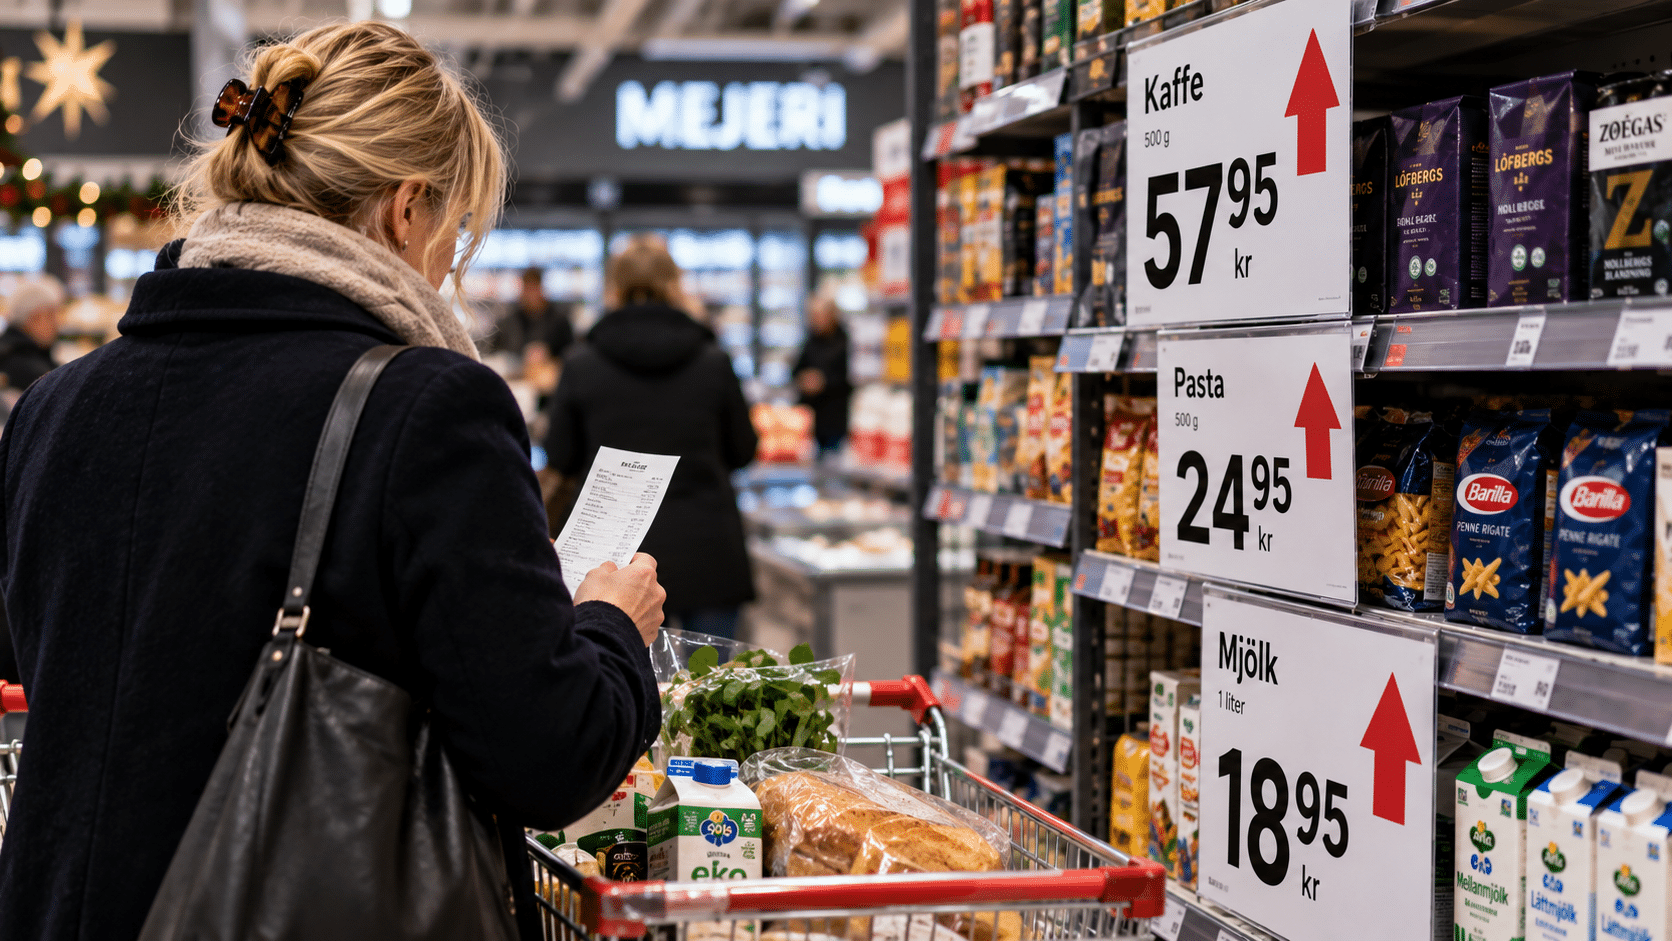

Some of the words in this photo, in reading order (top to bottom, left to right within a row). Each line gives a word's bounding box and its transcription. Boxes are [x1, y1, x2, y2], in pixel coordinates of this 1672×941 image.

[1144, 63, 1204, 115] Kaffe
[616, 81, 847, 150] MEJERI
[1144, 129, 1162, 149] 500
[1163, 131, 1170, 148] g
[1143, 162, 1223, 290] 57
[1227, 151, 1279, 229] 95
[1603, 169, 1654, 250] Z
[1234, 248, 1253, 279] kr
[1174, 366, 1225, 399] Pasta
[1175, 413, 1191, 428] 500
[1192, 416, 1199, 432] g
[1176, 450, 1250, 551] 24
[1250, 455, 1293, 514] 95
[1466, 482, 1513, 504] Barilla
[1572, 485, 1627, 511] Barilla
[1258, 524, 1273, 553] kr
[1456, 521, 1481, 533] PENNE
[1481, 523, 1511, 538] RIGATE
[1558, 528, 1586, 544] PENNE
[1587, 532, 1621, 548] RIGATE
[1218, 631, 1279, 686] Mjölk
[1218, 690, 1223, 709] 1
[1225, 692, 1246, 715] liter
[1218, 747, 1290, 887] 18
[1295, 771, 1349, 859] 95
[1472, 829, 1493, 847] Arla
[690, 859, 748, 881] eko
[1301, 865, 1321, 902] kr
[1456, 870, 1509, 906] Mellanmjölk
[1531, 889, 1578, 925] Lättmjölk
